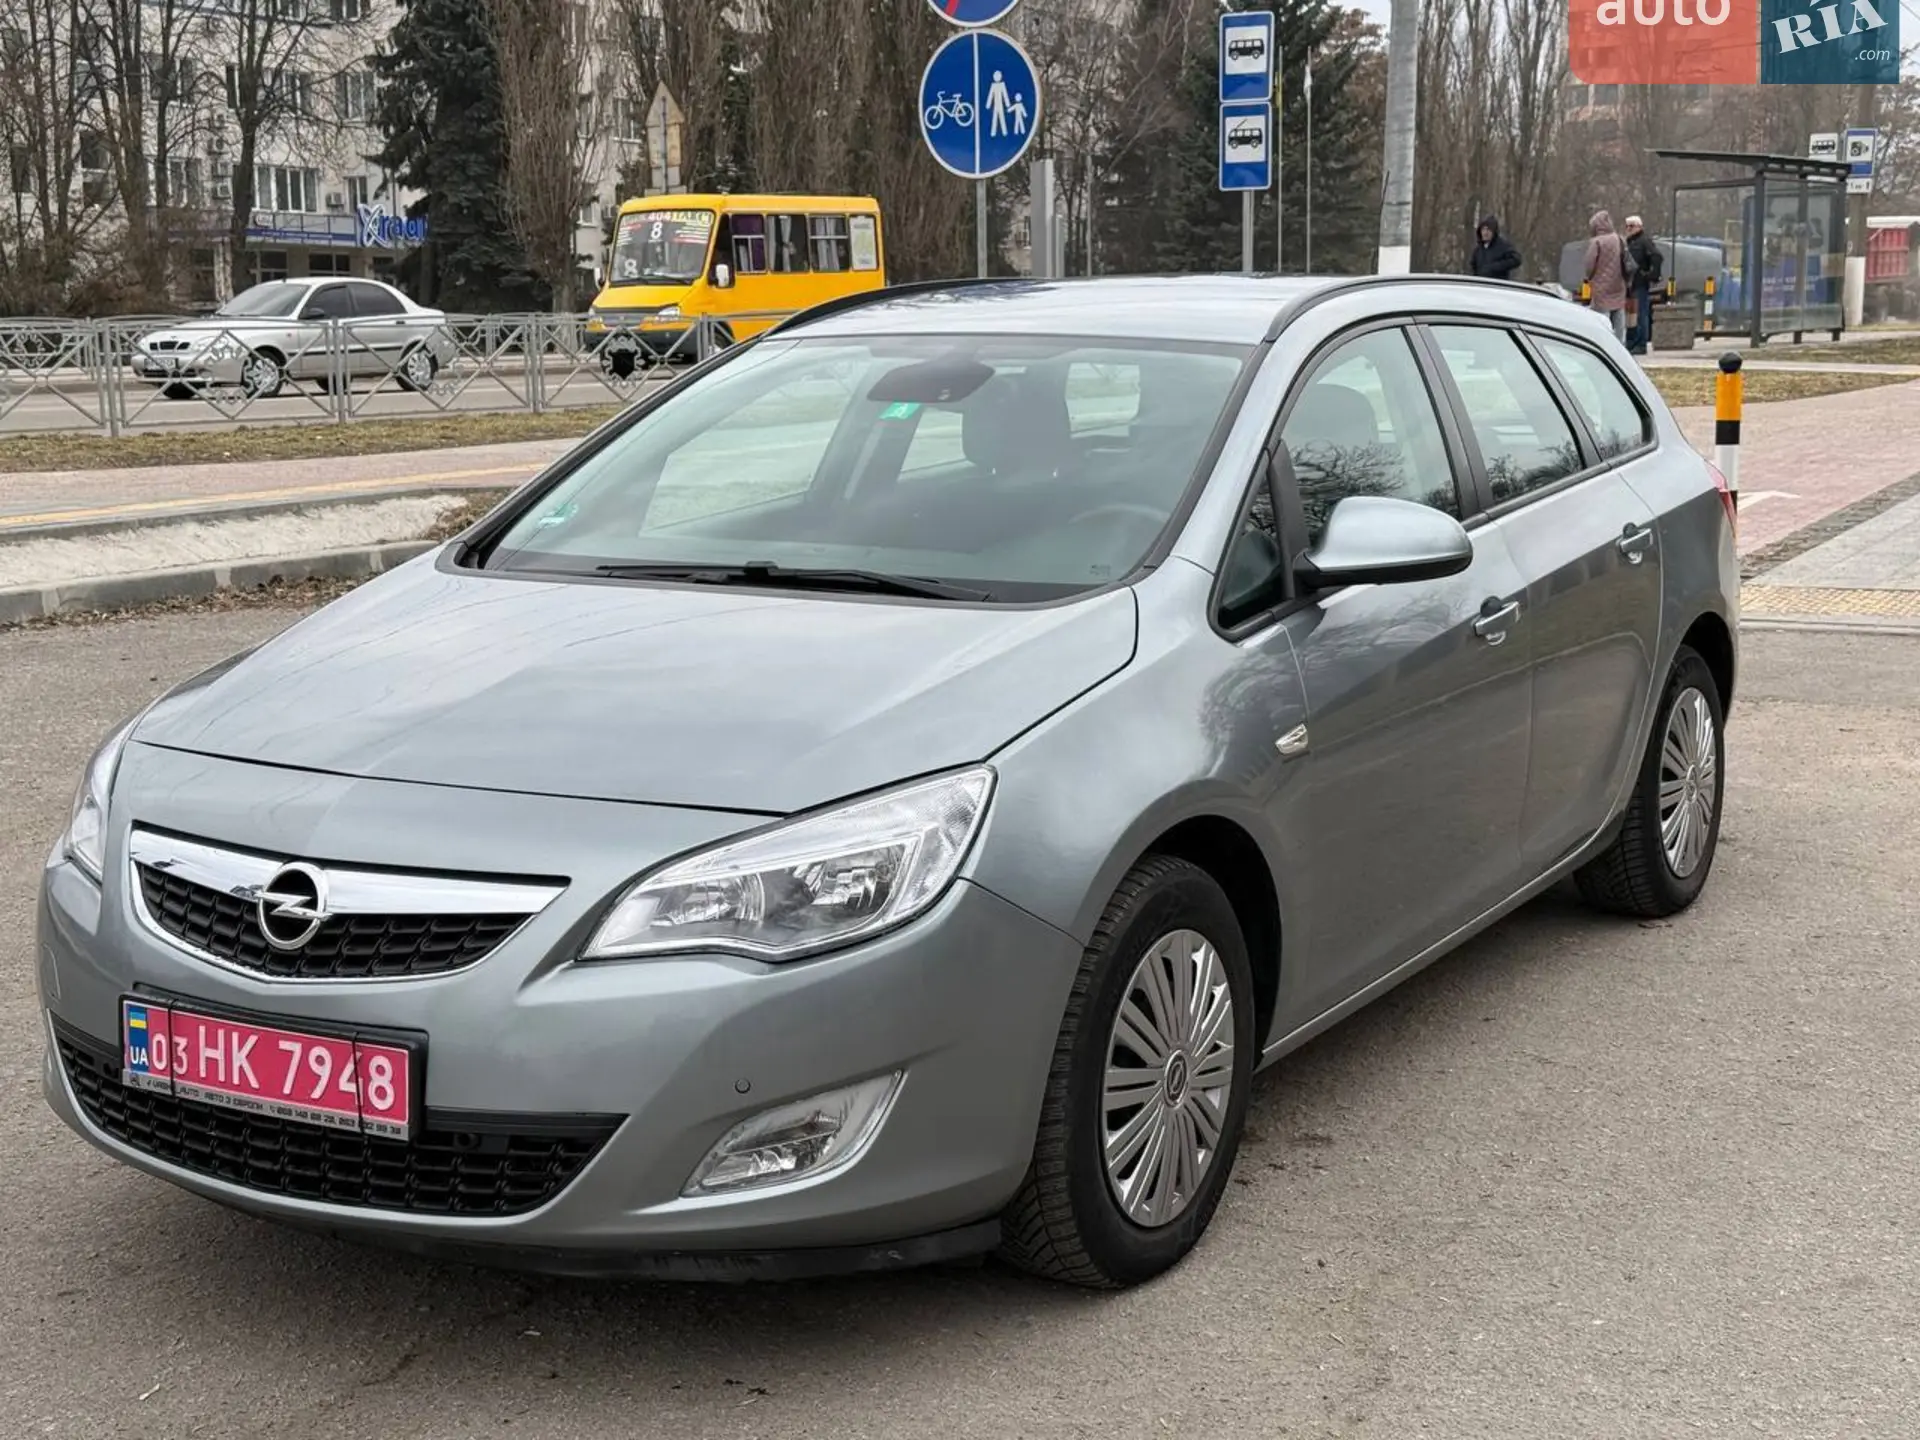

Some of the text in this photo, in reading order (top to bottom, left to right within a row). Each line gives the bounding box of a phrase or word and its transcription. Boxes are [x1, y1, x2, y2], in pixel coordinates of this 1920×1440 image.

[651, 221, 662, 239] 8
[624, 258, 639, 278] 8
[130, 1045, 149, 1066] UA
[152, 1025, 395, 1111] 03 HK 7948
